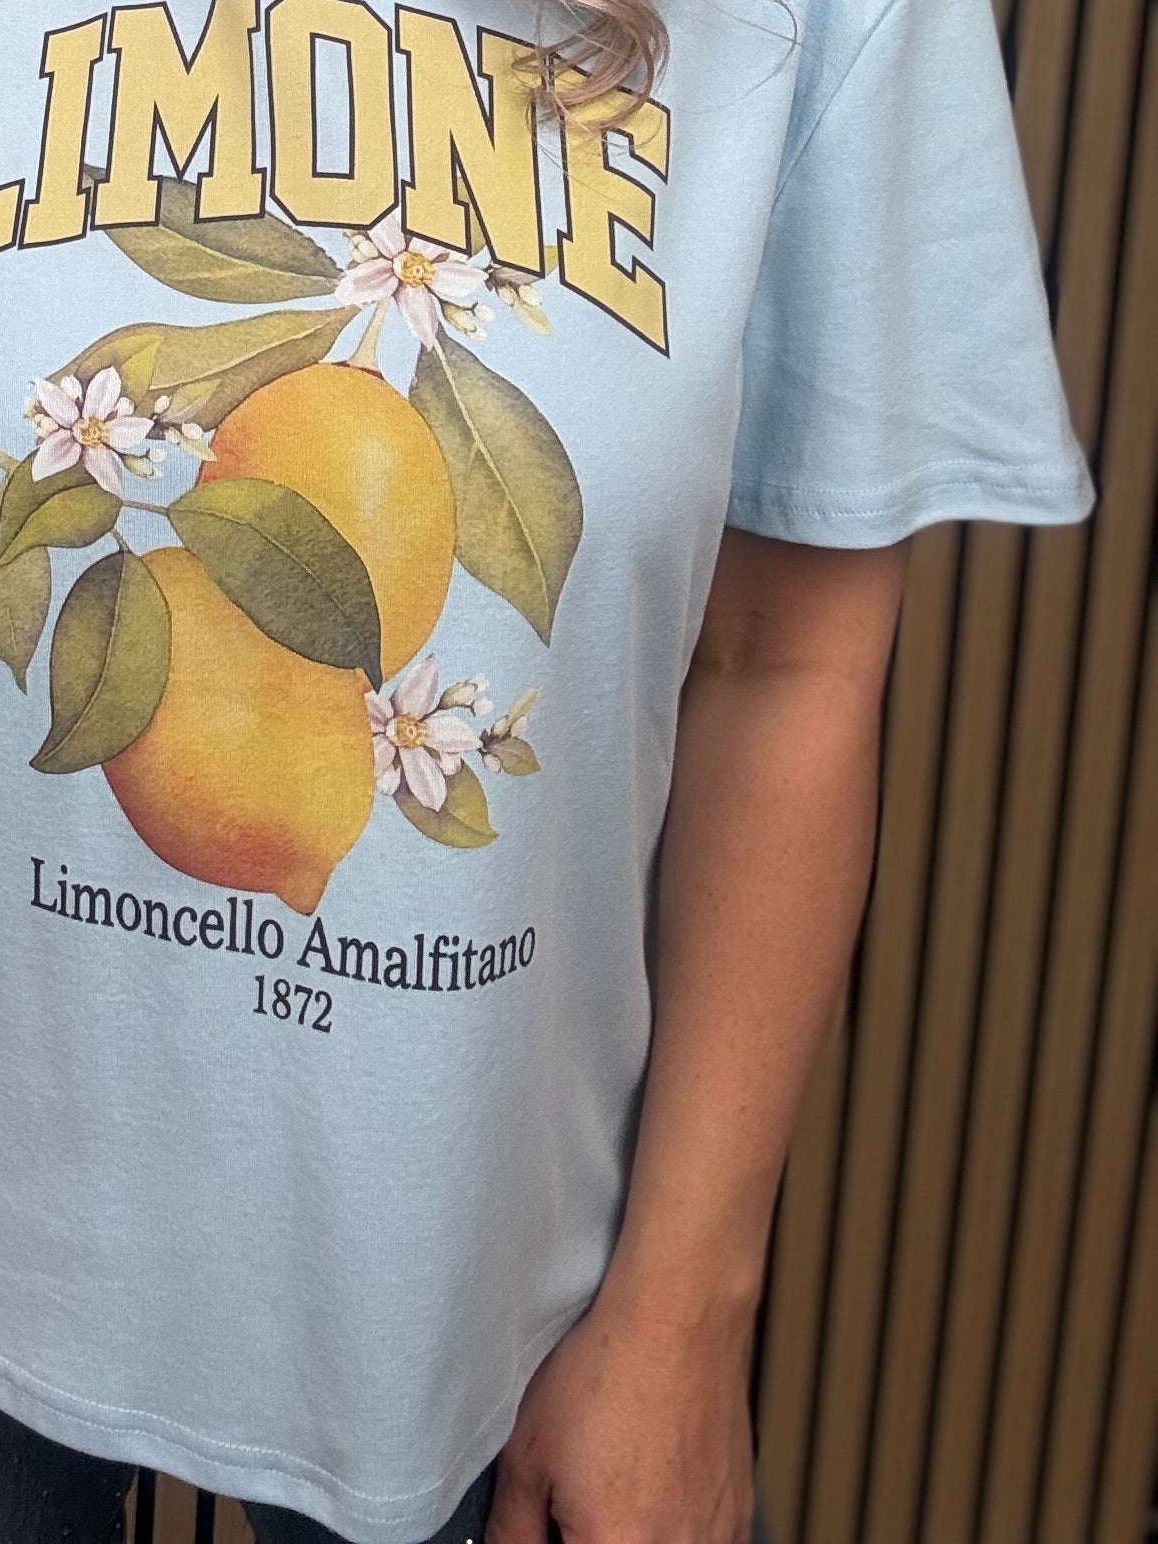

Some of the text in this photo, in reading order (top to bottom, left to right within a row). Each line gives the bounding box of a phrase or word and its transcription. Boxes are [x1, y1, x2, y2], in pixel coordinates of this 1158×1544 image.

[30, 857, 536, 992] Limoncello Amalfitano
[253, 975, 333, 1034] 1872
